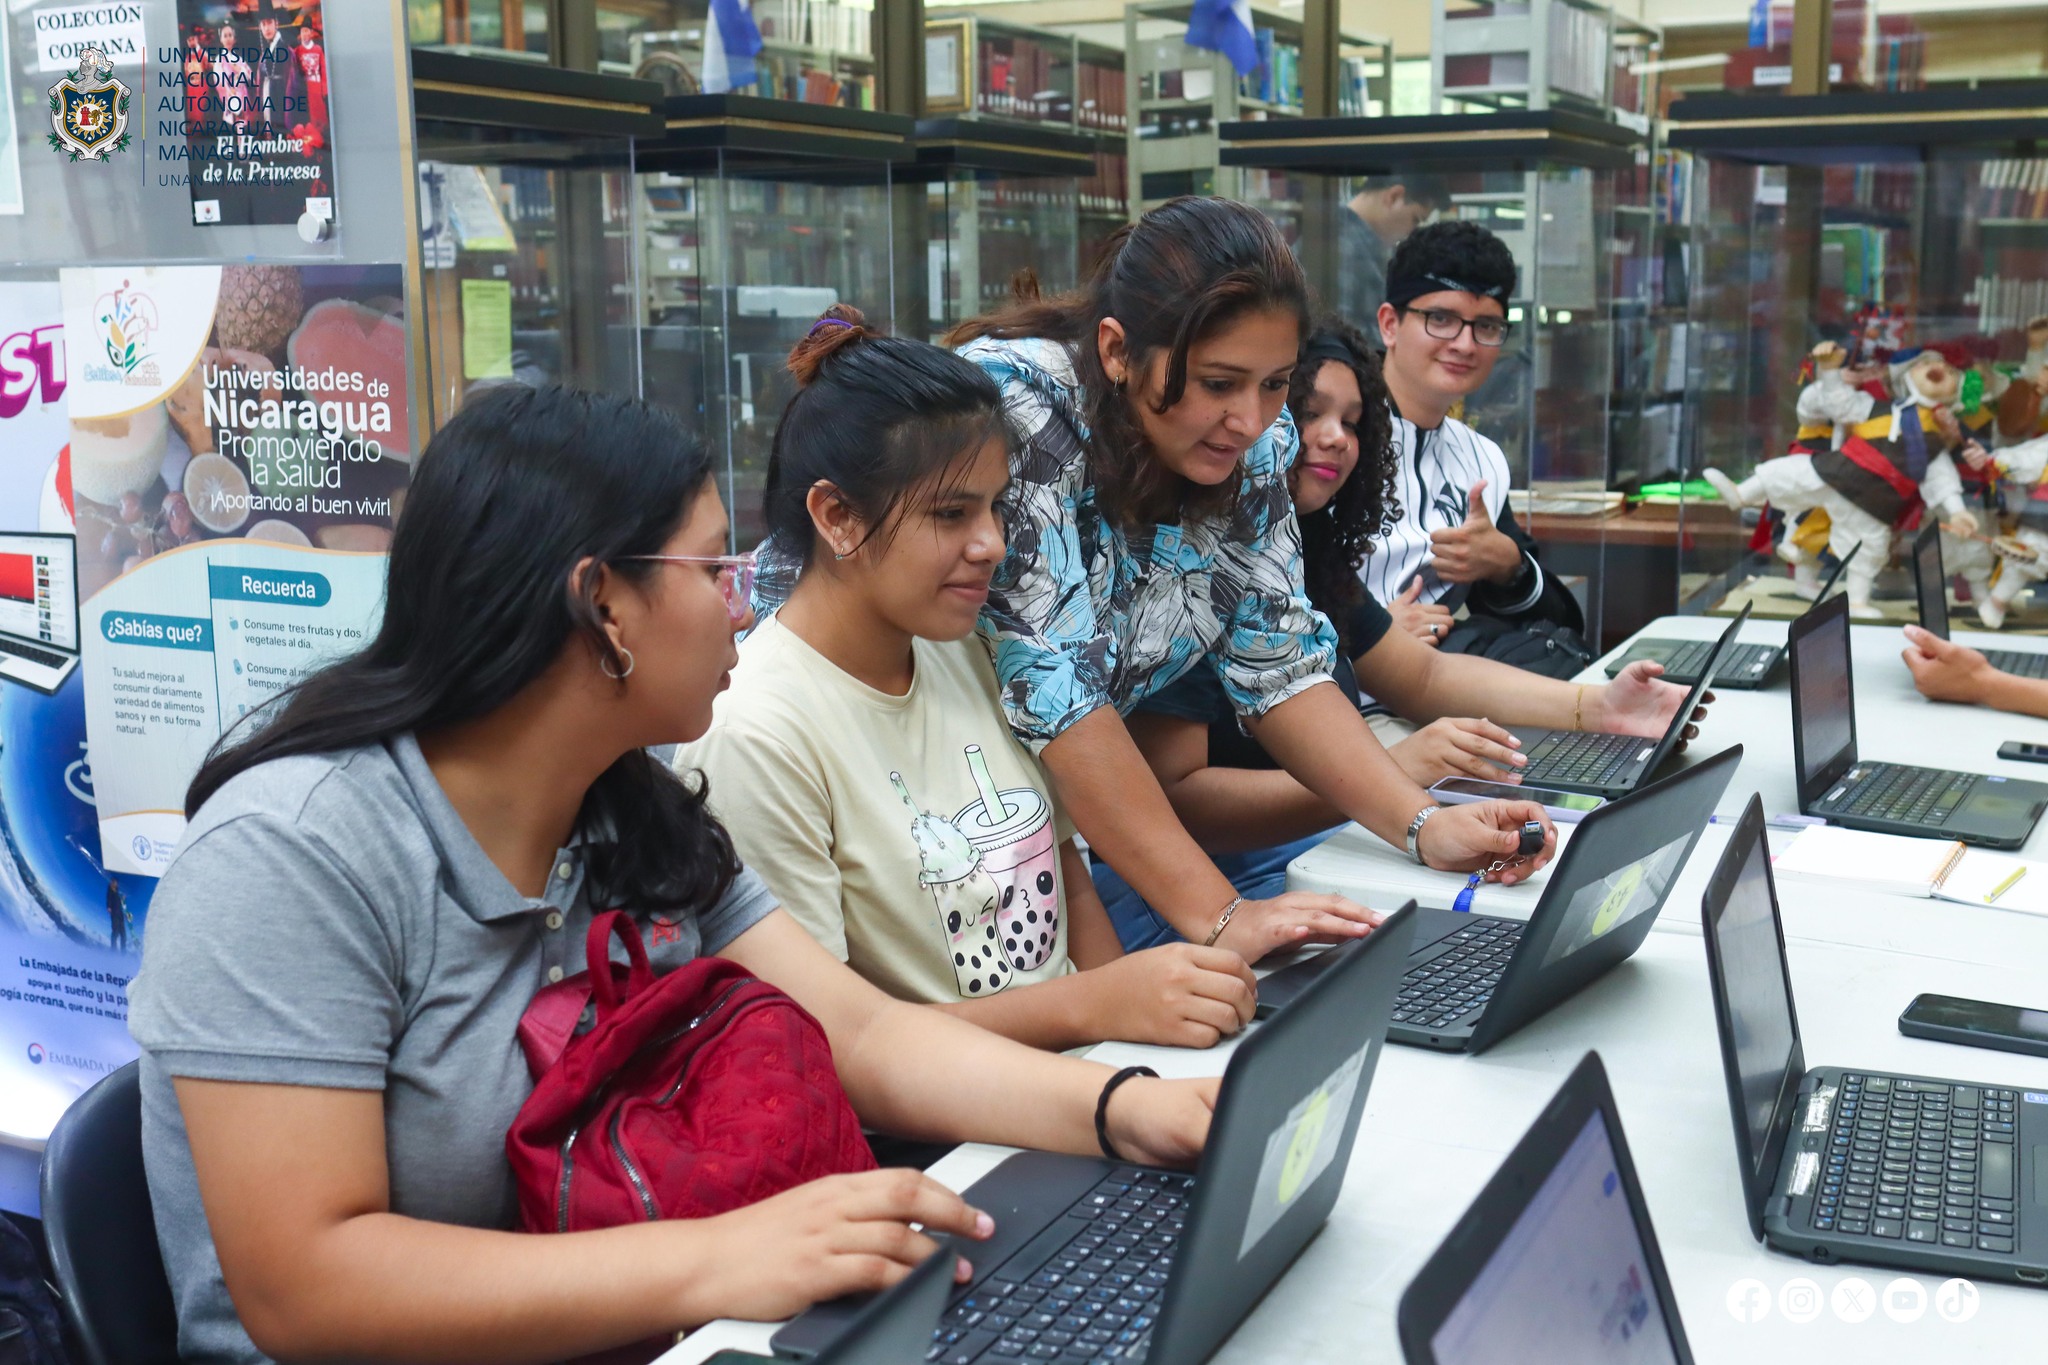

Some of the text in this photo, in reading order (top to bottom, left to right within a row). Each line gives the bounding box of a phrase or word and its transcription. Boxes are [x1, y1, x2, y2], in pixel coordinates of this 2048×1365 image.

[37, 5, 141, 31] COLECCIÓN
[217, 134, 304, 156] El Hombre
[203, 161, 321, 183] de la Princesa
[203, 364, 390, 398] Universidades de
[203, 389, 391, 440] Nicaragua
[218, 429, 382, 463] Promoviendo
[249, 456, 341, 489] la Salud
[295, 494, 308, 513] al
[312, 495, 351, 515] buen
[241, 575, 316, 599] Recuerda
[107, 617, 202, 644] ¿Sabías que?
[244, 618, 362, 639] Consume tres frutas y dos
[245, 635, 287, 647] vegetales
[288, 638, 296, 648] al
[112, 667, 185, 683] Tu salud mejora al
[247, 662, 287, 676] Consume
[289, 667, 297, 677] al
[113, 683, 203, 699] consumir diariamente
[248, 678, 282, 690] tiempos
[114, 697, 205, 714] variedad de alimentos
[115, 710, 201, 727] sanos y en su forma
[19, 956, 30, 968] La
[31, 958, 79, 978] Embajada
[80, 968, 93, 980] de
[94, 970, 104, 983] la
[27, 978, 52, 991] apoya
[54, 982, 61, 991] el
[64, 985, 94, 999] sueño
[96, 992, 103, 1003] y
[105, 991, 115, 1003] la
[23, 992, 67, 1010] coreana,
[68, 1001, 83, 1012] que
[85, 1006, 94, 1015] es
[95, 1006, 103, 1017] la
[104, 1009, 122, 1021] más
[49, 1051, 105, 1073] EMBAJADA
